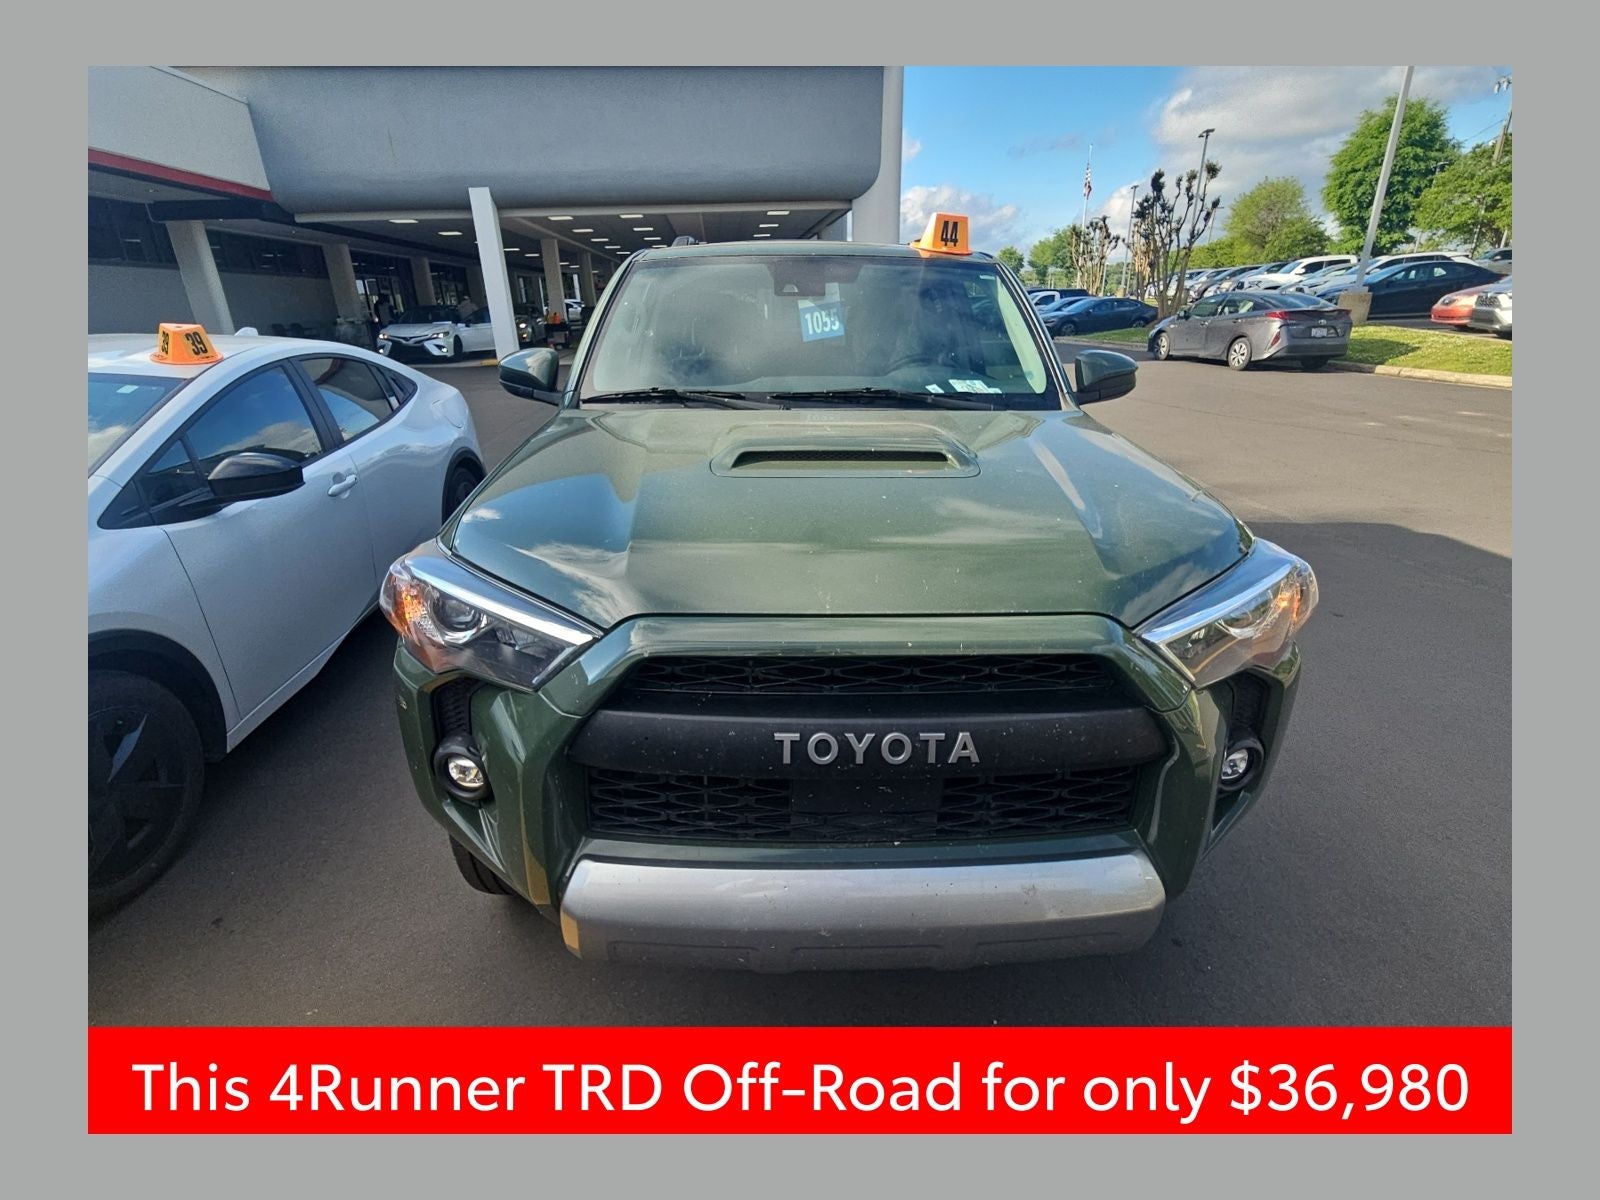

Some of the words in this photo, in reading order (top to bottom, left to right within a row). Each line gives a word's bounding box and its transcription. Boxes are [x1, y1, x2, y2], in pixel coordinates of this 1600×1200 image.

[940, 220, 958, 247] 44
[804, 308, 841, 335] 1055
[184, 331, 208, 356] 39
[773, 731, 981, 765] TOYOTA
